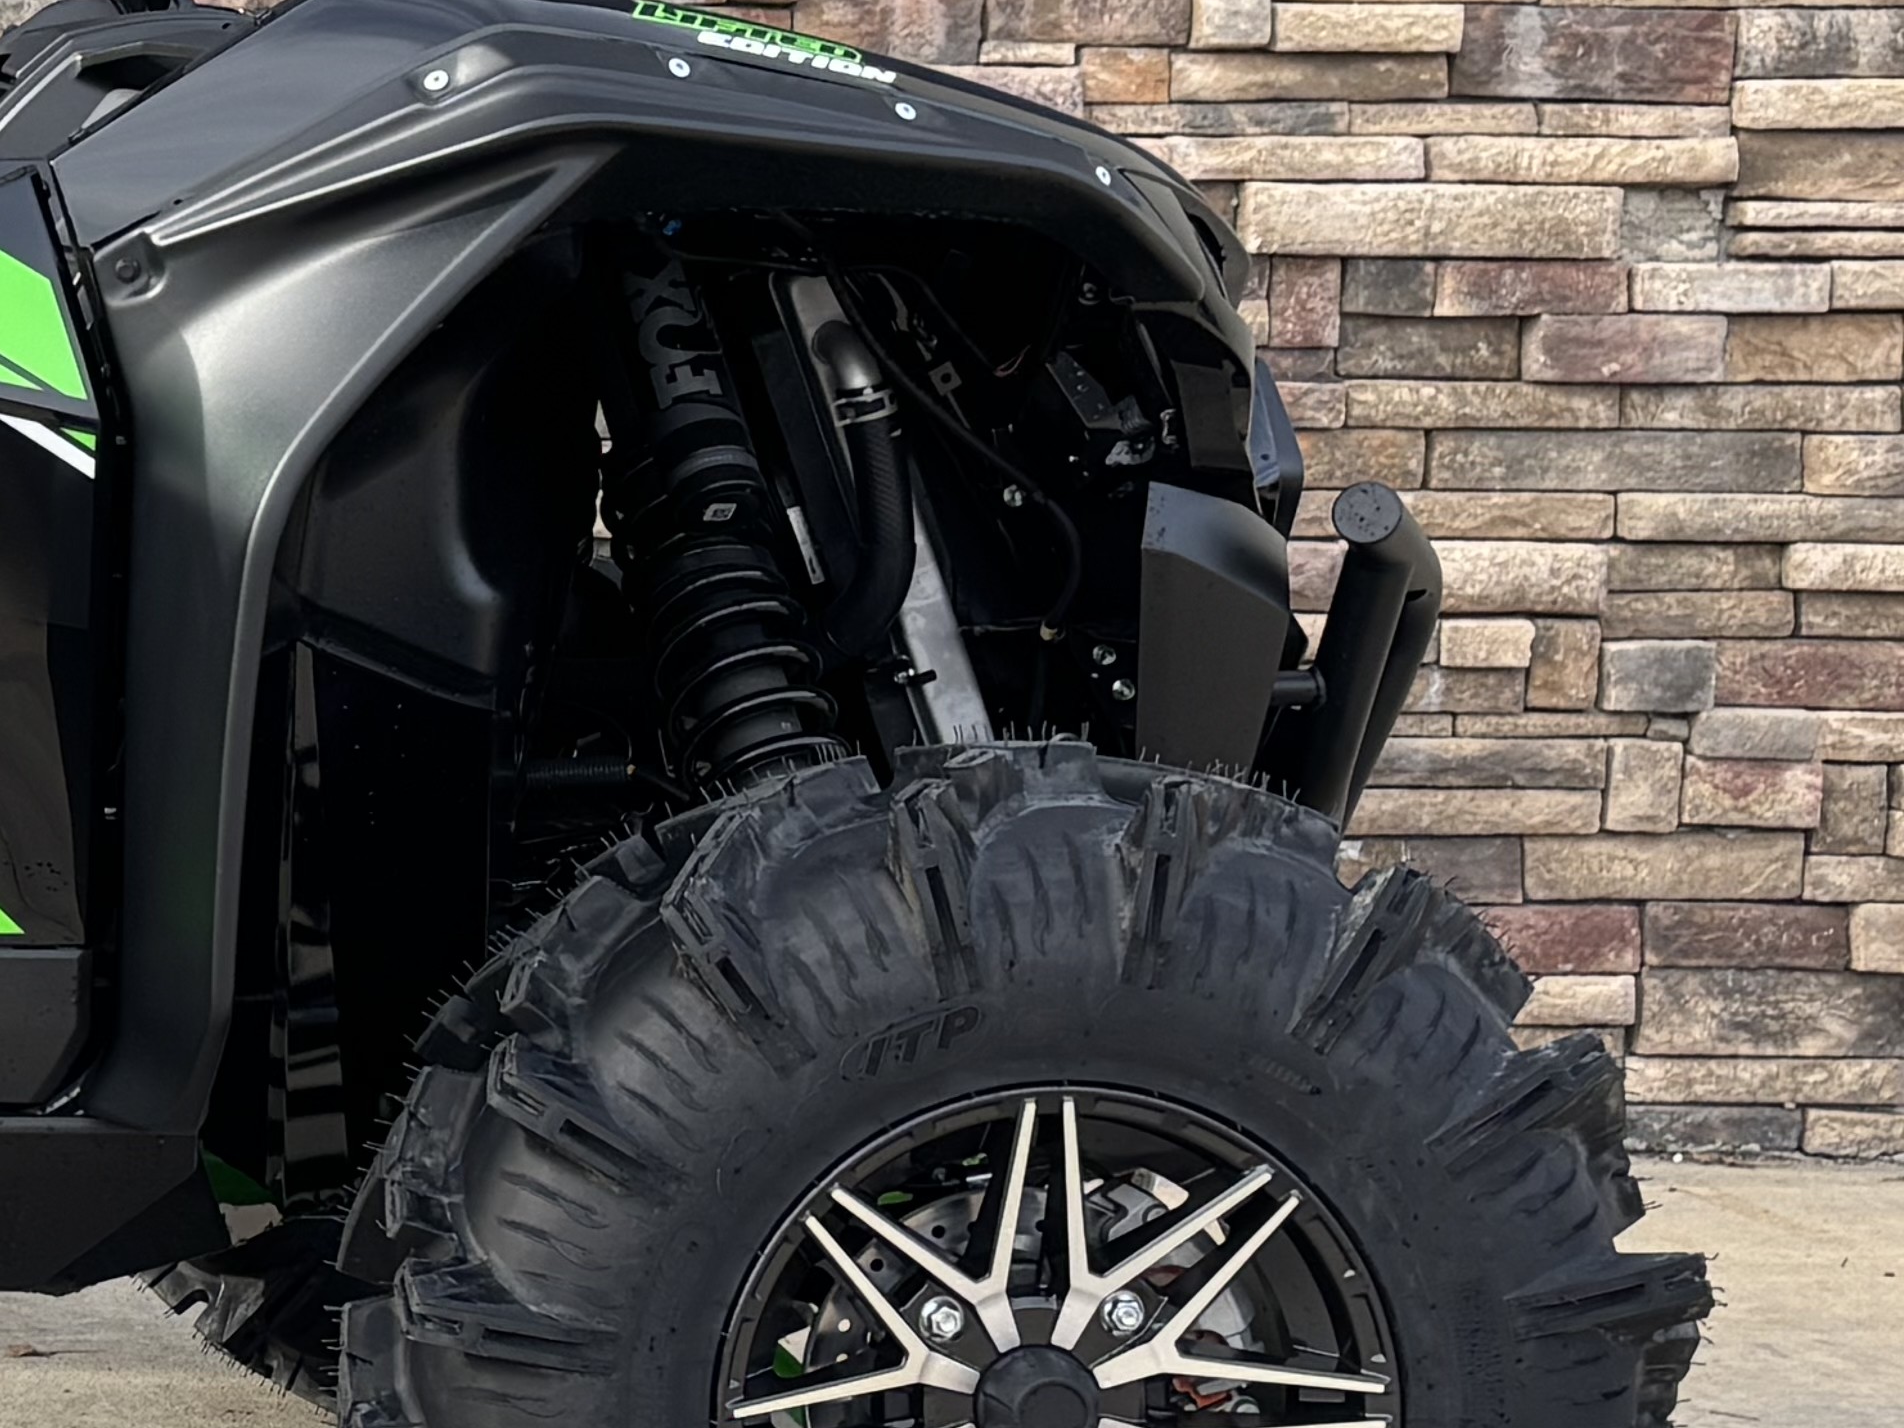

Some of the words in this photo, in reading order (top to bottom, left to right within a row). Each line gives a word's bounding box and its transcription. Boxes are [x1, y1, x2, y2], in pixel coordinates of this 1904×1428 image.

[696, 29, 897, 83] EDITION
[623, 256, 723, 411] FOX
[864, 1006, 981, 1076] ITP
